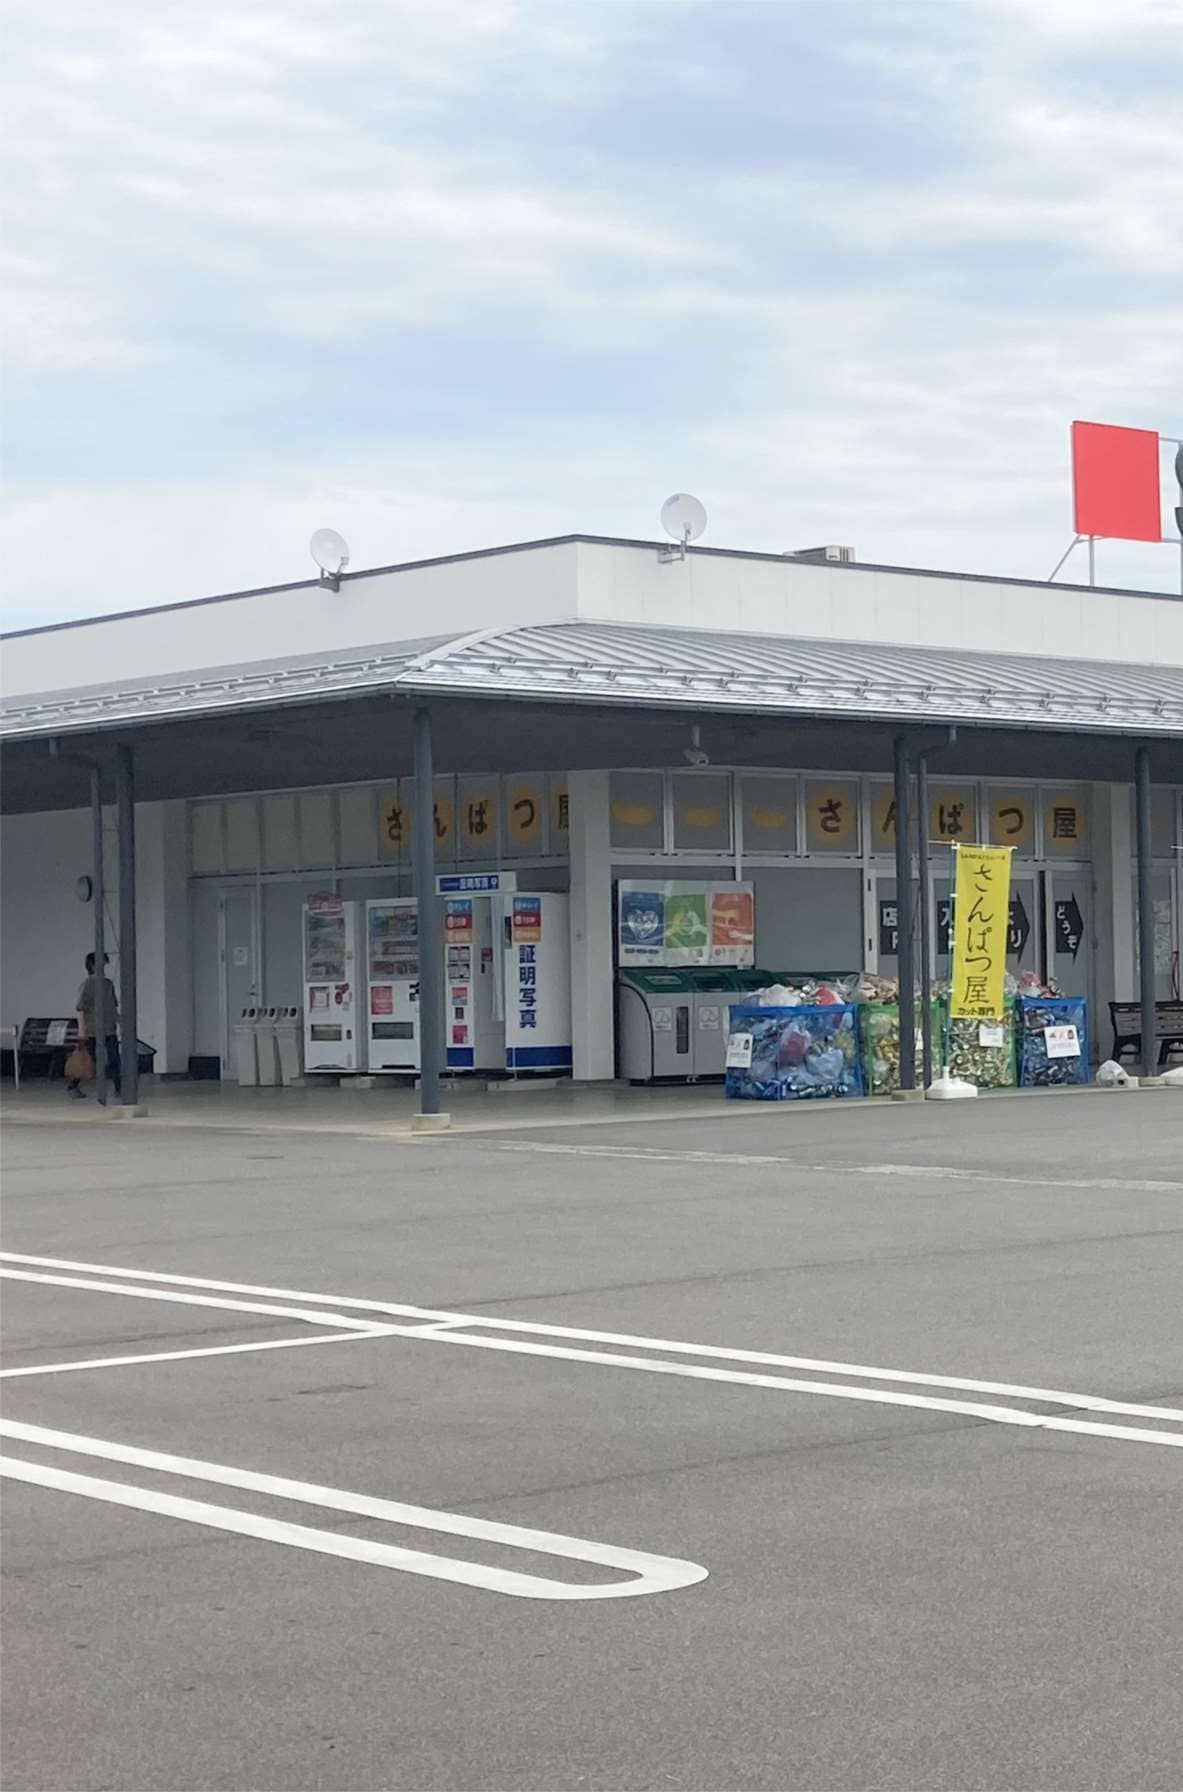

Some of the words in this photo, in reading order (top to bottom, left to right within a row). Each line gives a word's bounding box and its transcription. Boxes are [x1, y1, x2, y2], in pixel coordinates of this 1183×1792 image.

[963, 864, 994, 1004] さんぱつ屋
[1056, 905, 1077, 949] どうぞ
[519, 944, 537, 1029] 証明写真
[957, 1006, 996, 1017] カット専門
